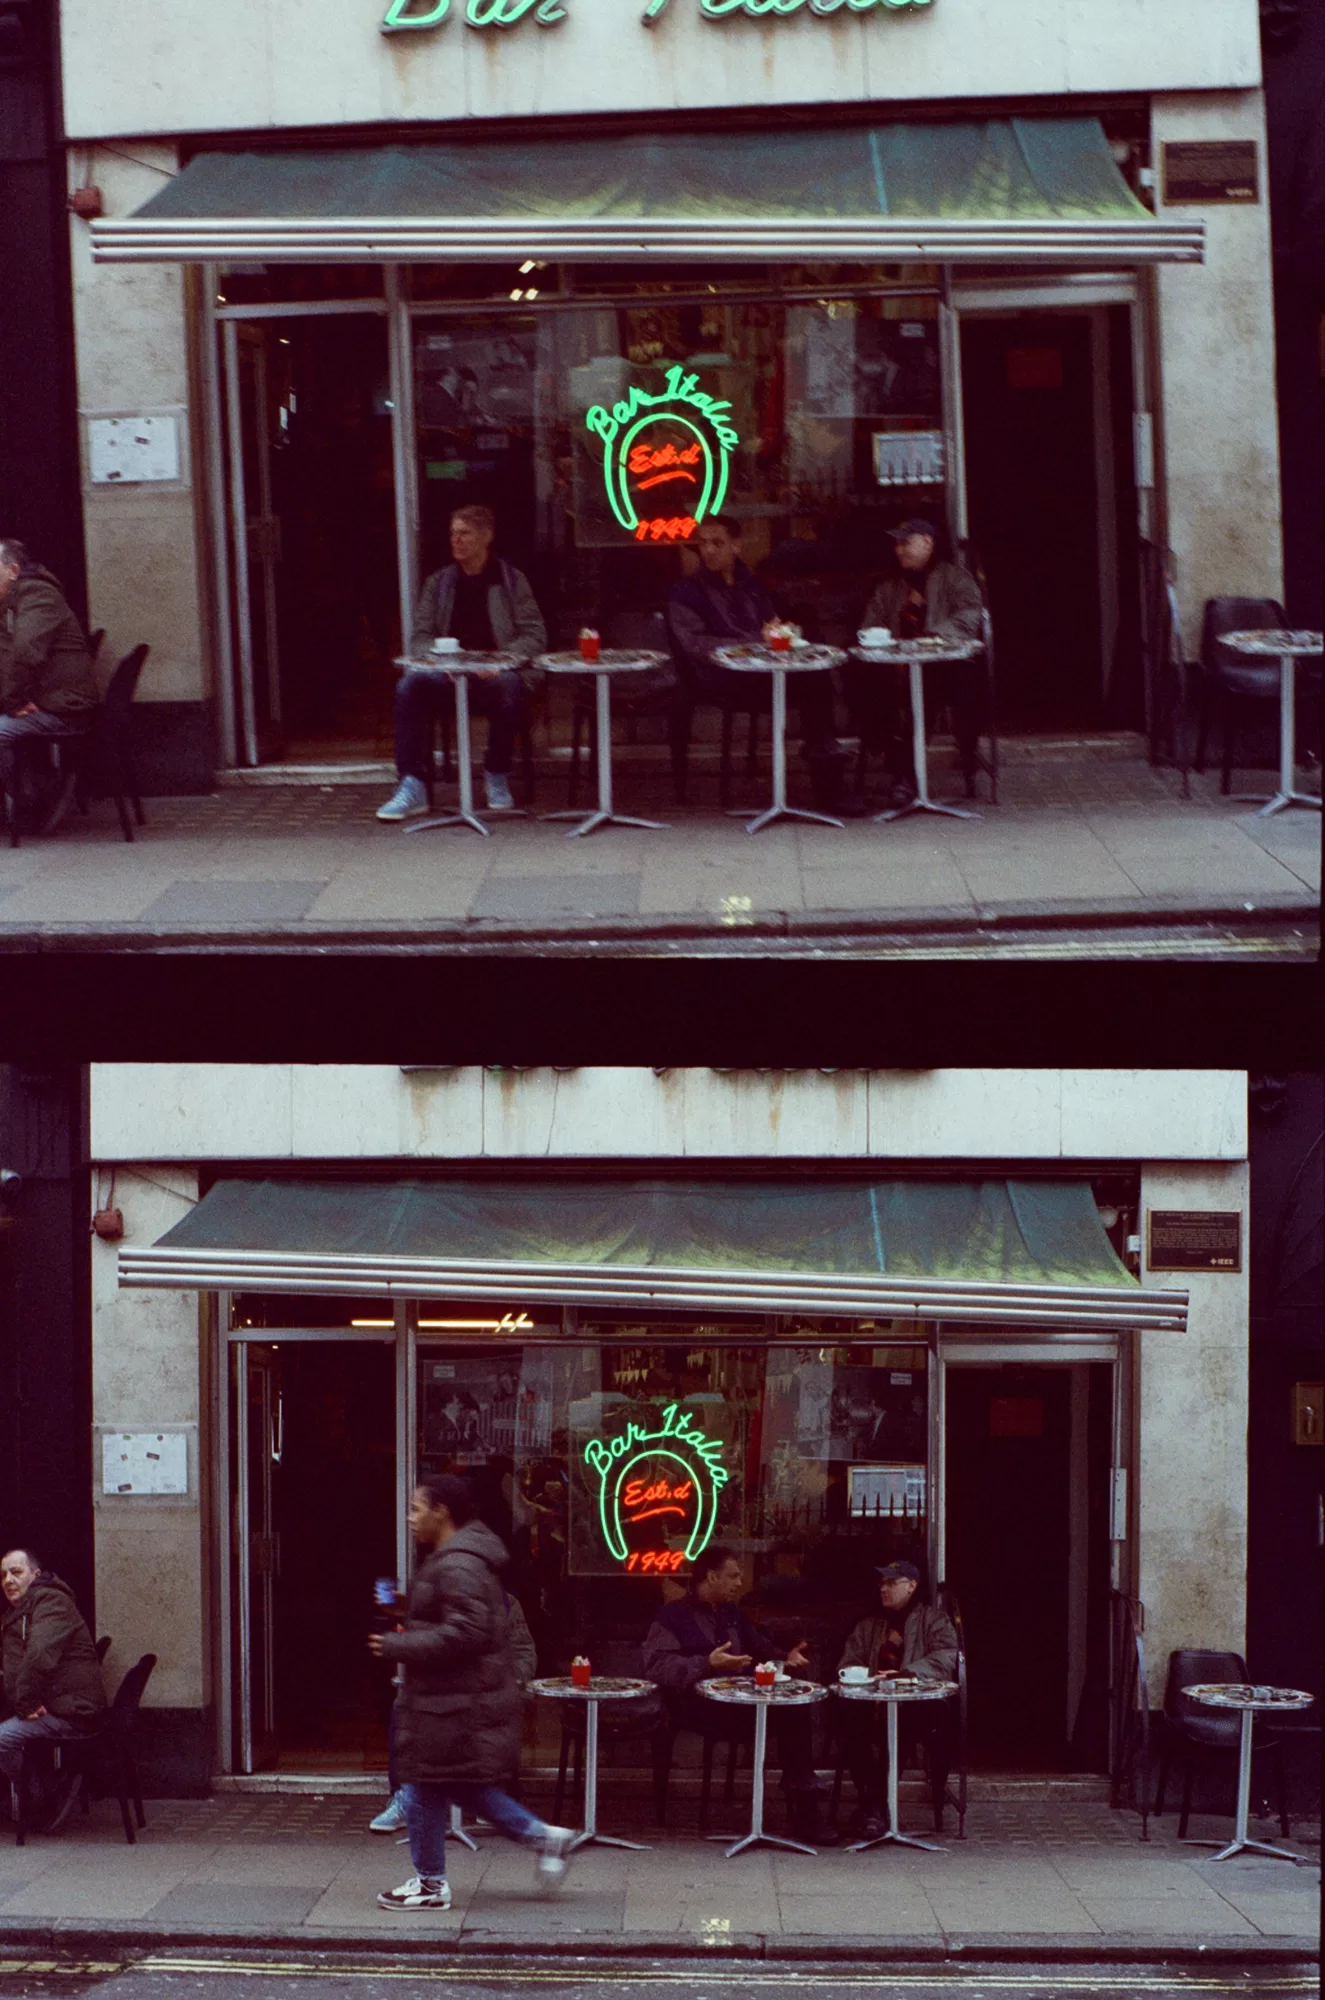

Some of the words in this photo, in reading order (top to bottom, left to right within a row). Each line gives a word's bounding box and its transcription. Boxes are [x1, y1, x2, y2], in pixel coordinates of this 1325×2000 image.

[585, 385, 651, 444] Bar
[664, 365, 740, 451] Italia
[635, 516, 697, 541] 1949
[584, 1422, 647, 1476] Bar
[662, 1403, 729, 1488] Italia
[627, 1551, 686, 1571] 1949
